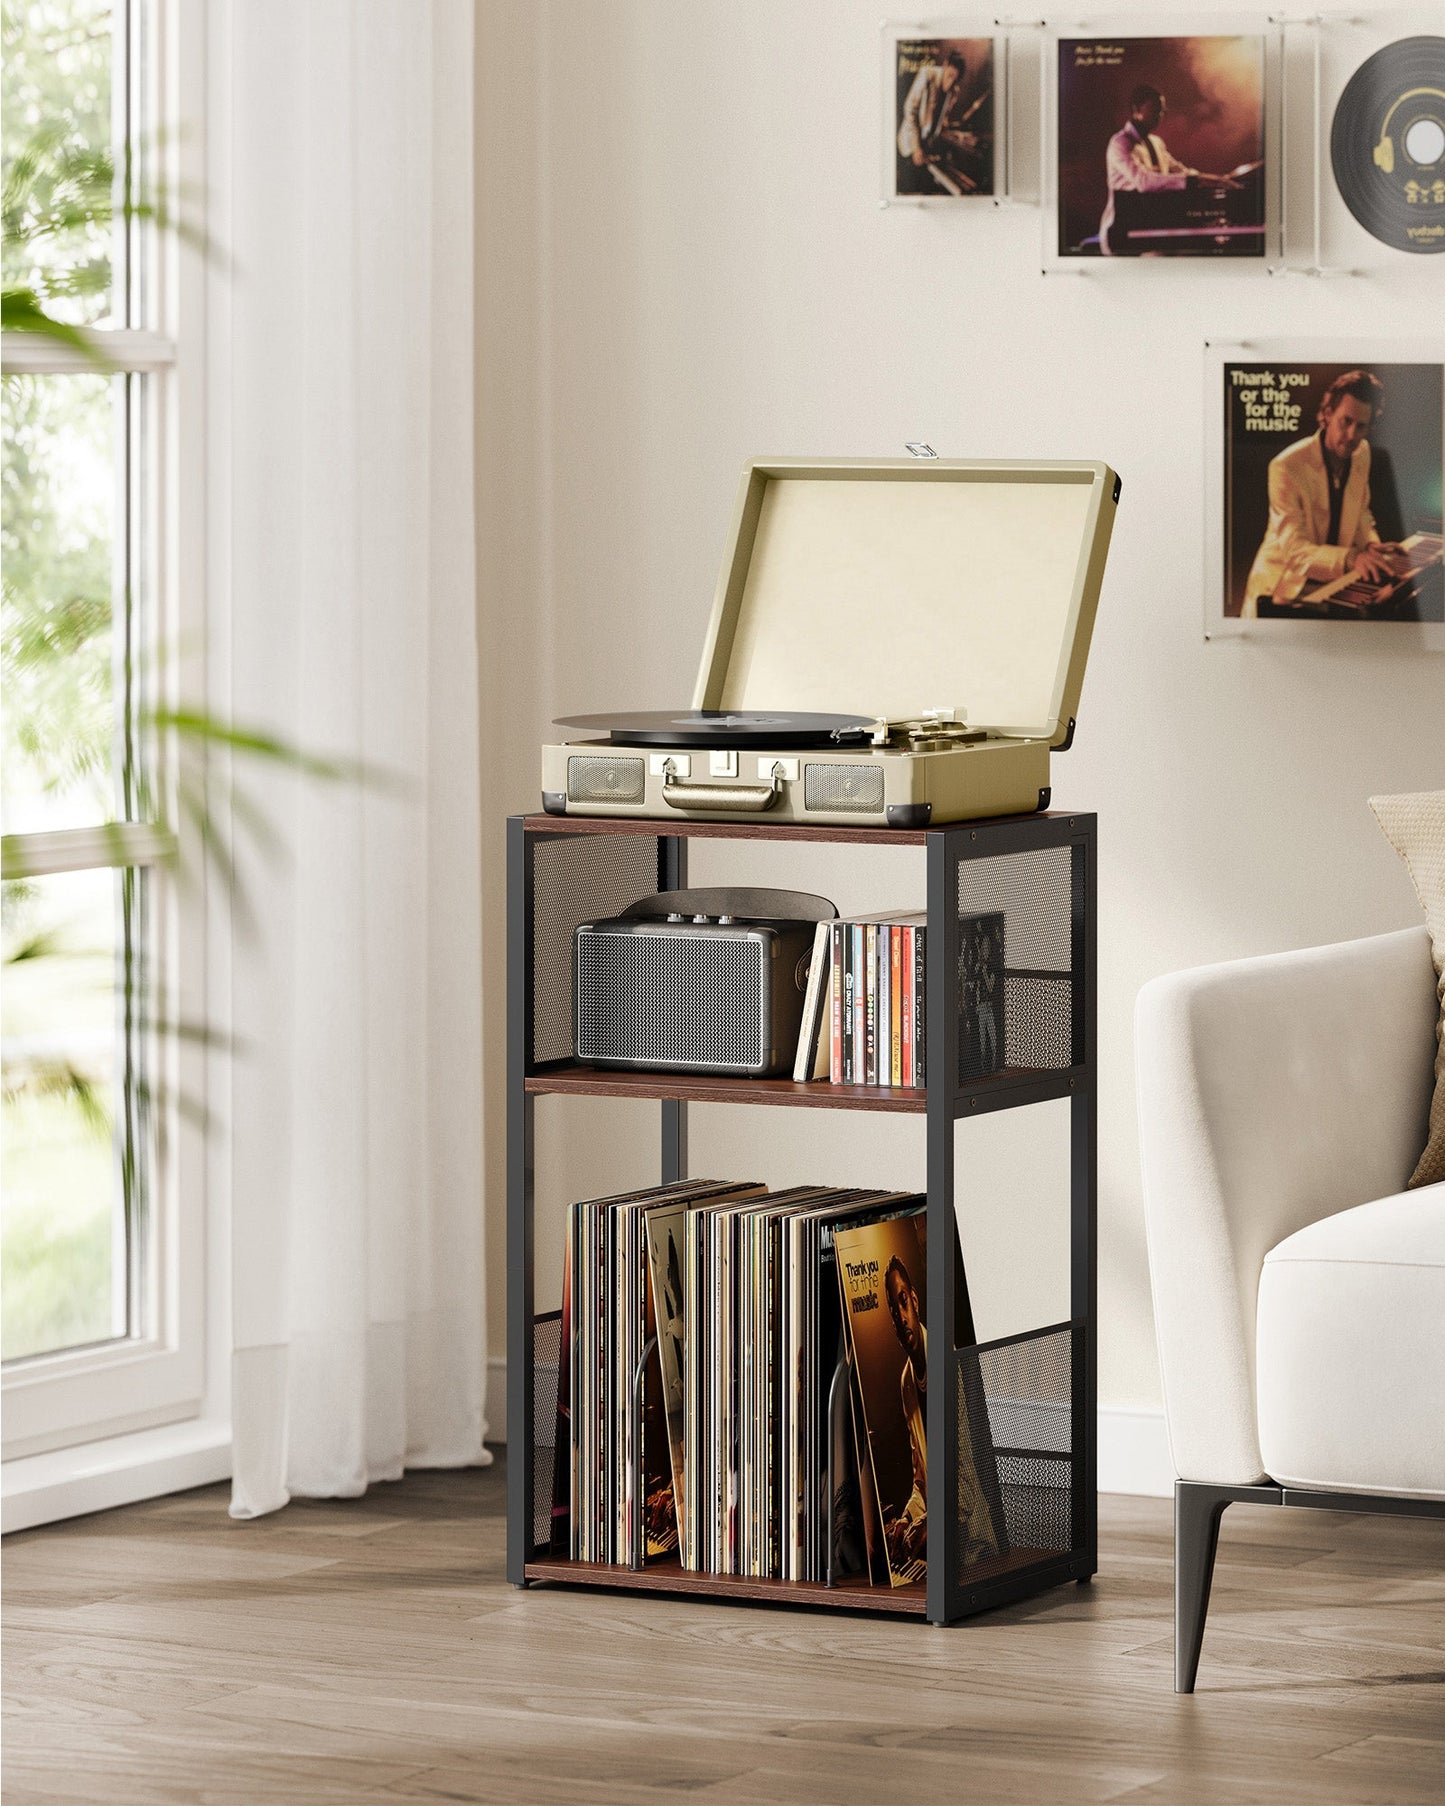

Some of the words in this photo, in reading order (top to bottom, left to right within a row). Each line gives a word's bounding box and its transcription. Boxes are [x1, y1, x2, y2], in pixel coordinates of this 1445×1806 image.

[1230, 370, 1275, 386] Thank
[1279, 372, 1310, 389] you
[1239, 390, 1258, 402] or
[1262, 388, 1290, 402] the
[1245, 402, 1269, 417] for
[1273, 402, 1302, 418] the
[1246, 416, 1299, 432] music
[845, 1260, 867, 1278] Thank
[866, 1260, 879, 1277] you
